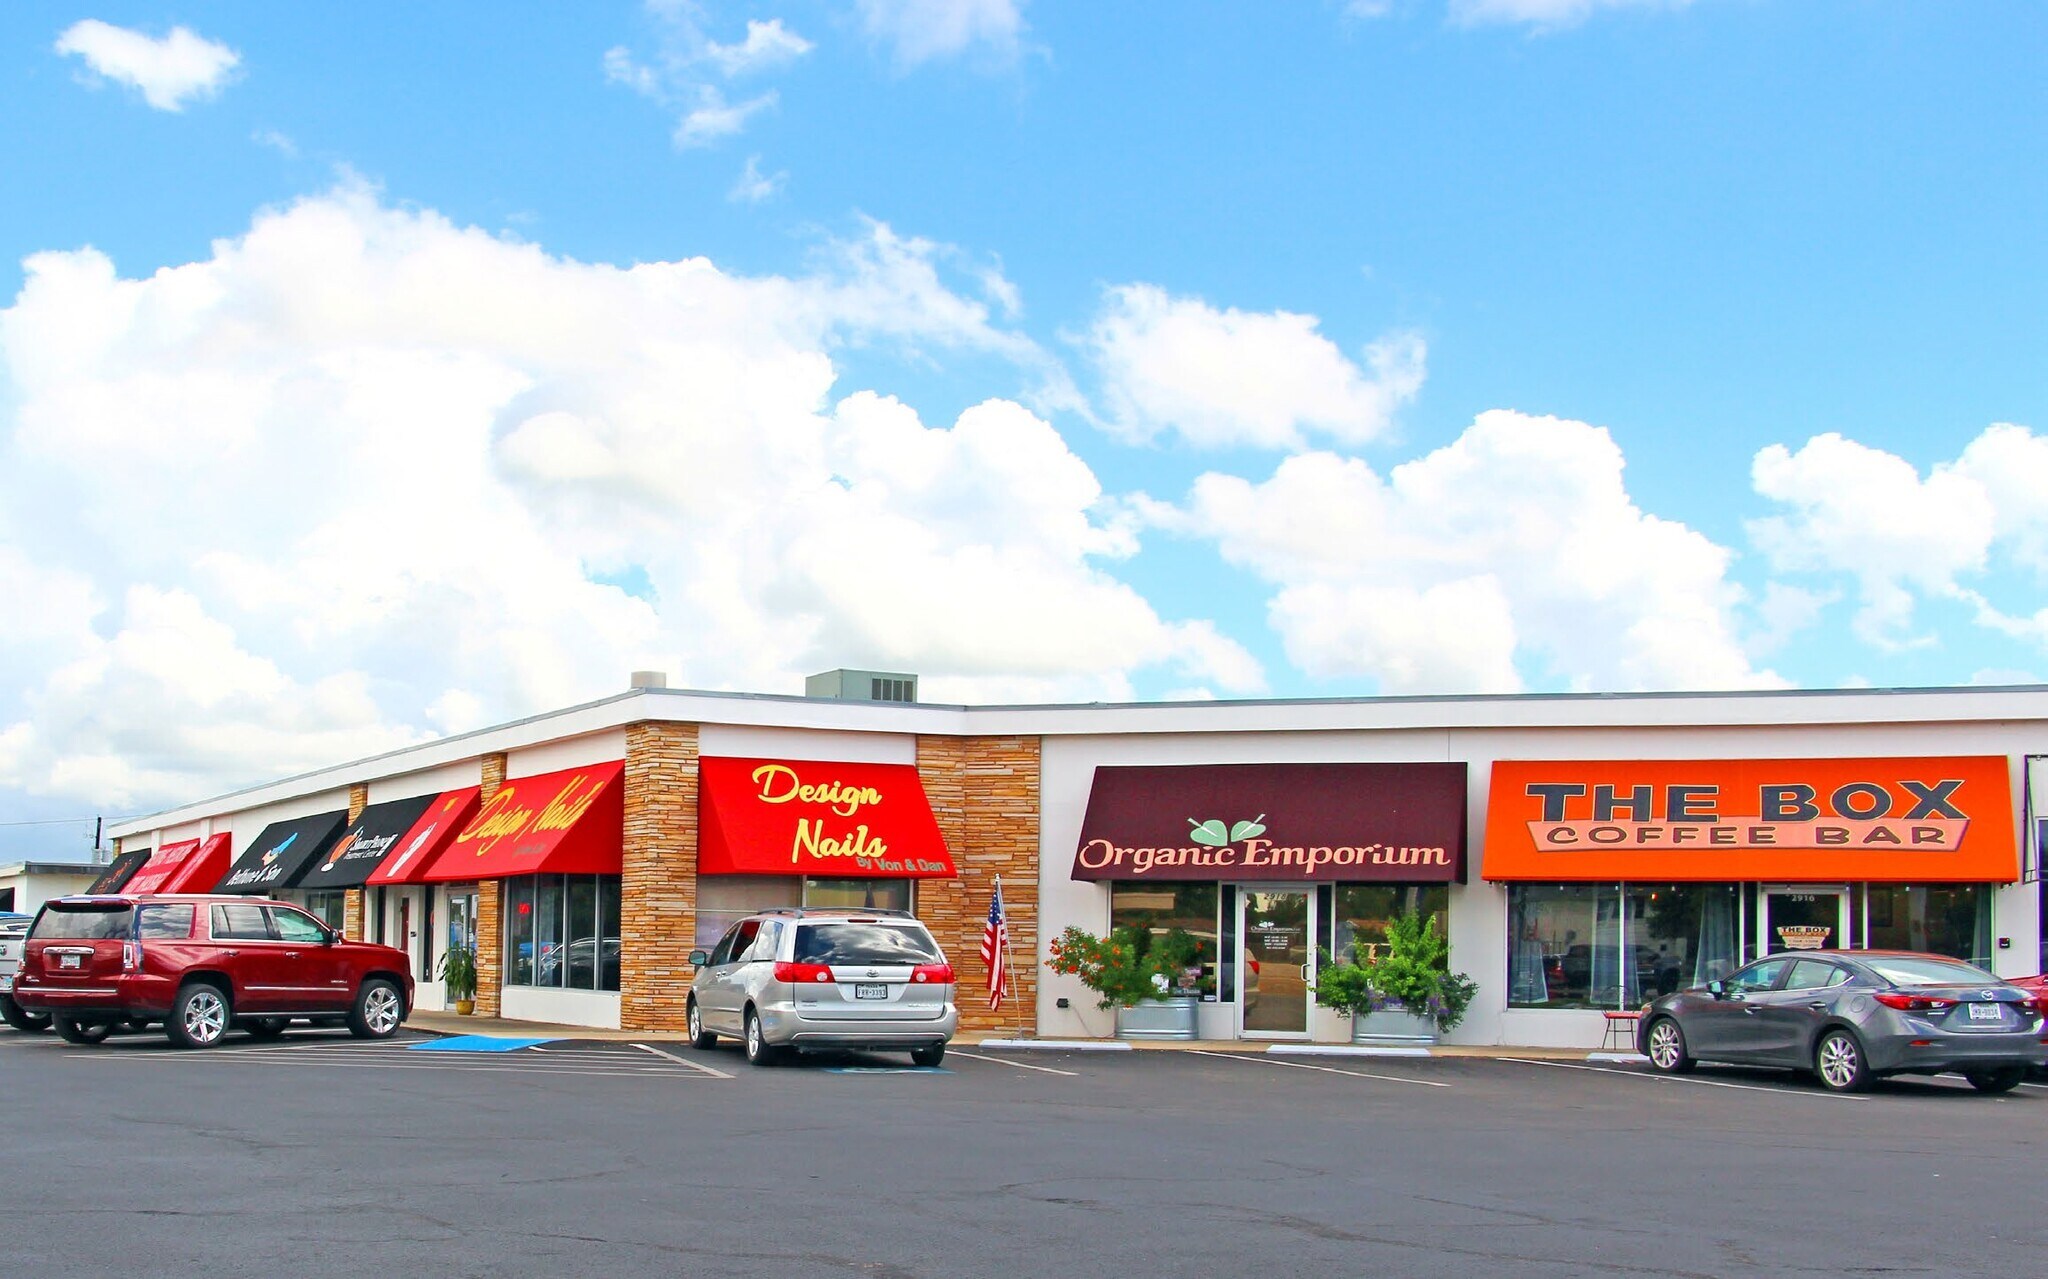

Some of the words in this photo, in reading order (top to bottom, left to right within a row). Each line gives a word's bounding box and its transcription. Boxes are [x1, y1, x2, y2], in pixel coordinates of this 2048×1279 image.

[752, 764, 882, 816] Design
[1525, 784, 1720, 823] THE
[1760, 780, 1970, 823] BOX
[457, 787, 533, 857] Design
[514, 774, 605, 841] Nails
[792, 818, 887, 864] Nails
[1546, 826, 1777, 845] COFFEE
[1815, 826, 1946, 845] BAR
[855, 857, 873, 871] By
[876, 858, 902, 872] Von
[906, 859, 916, 871] &
[918, 859, 947, 872] Dan
[1079, 839, 1236, 874] Organic
[1242, 839, 1451, 873] Emporium
[1791, 894, 1815, 902] 2916
